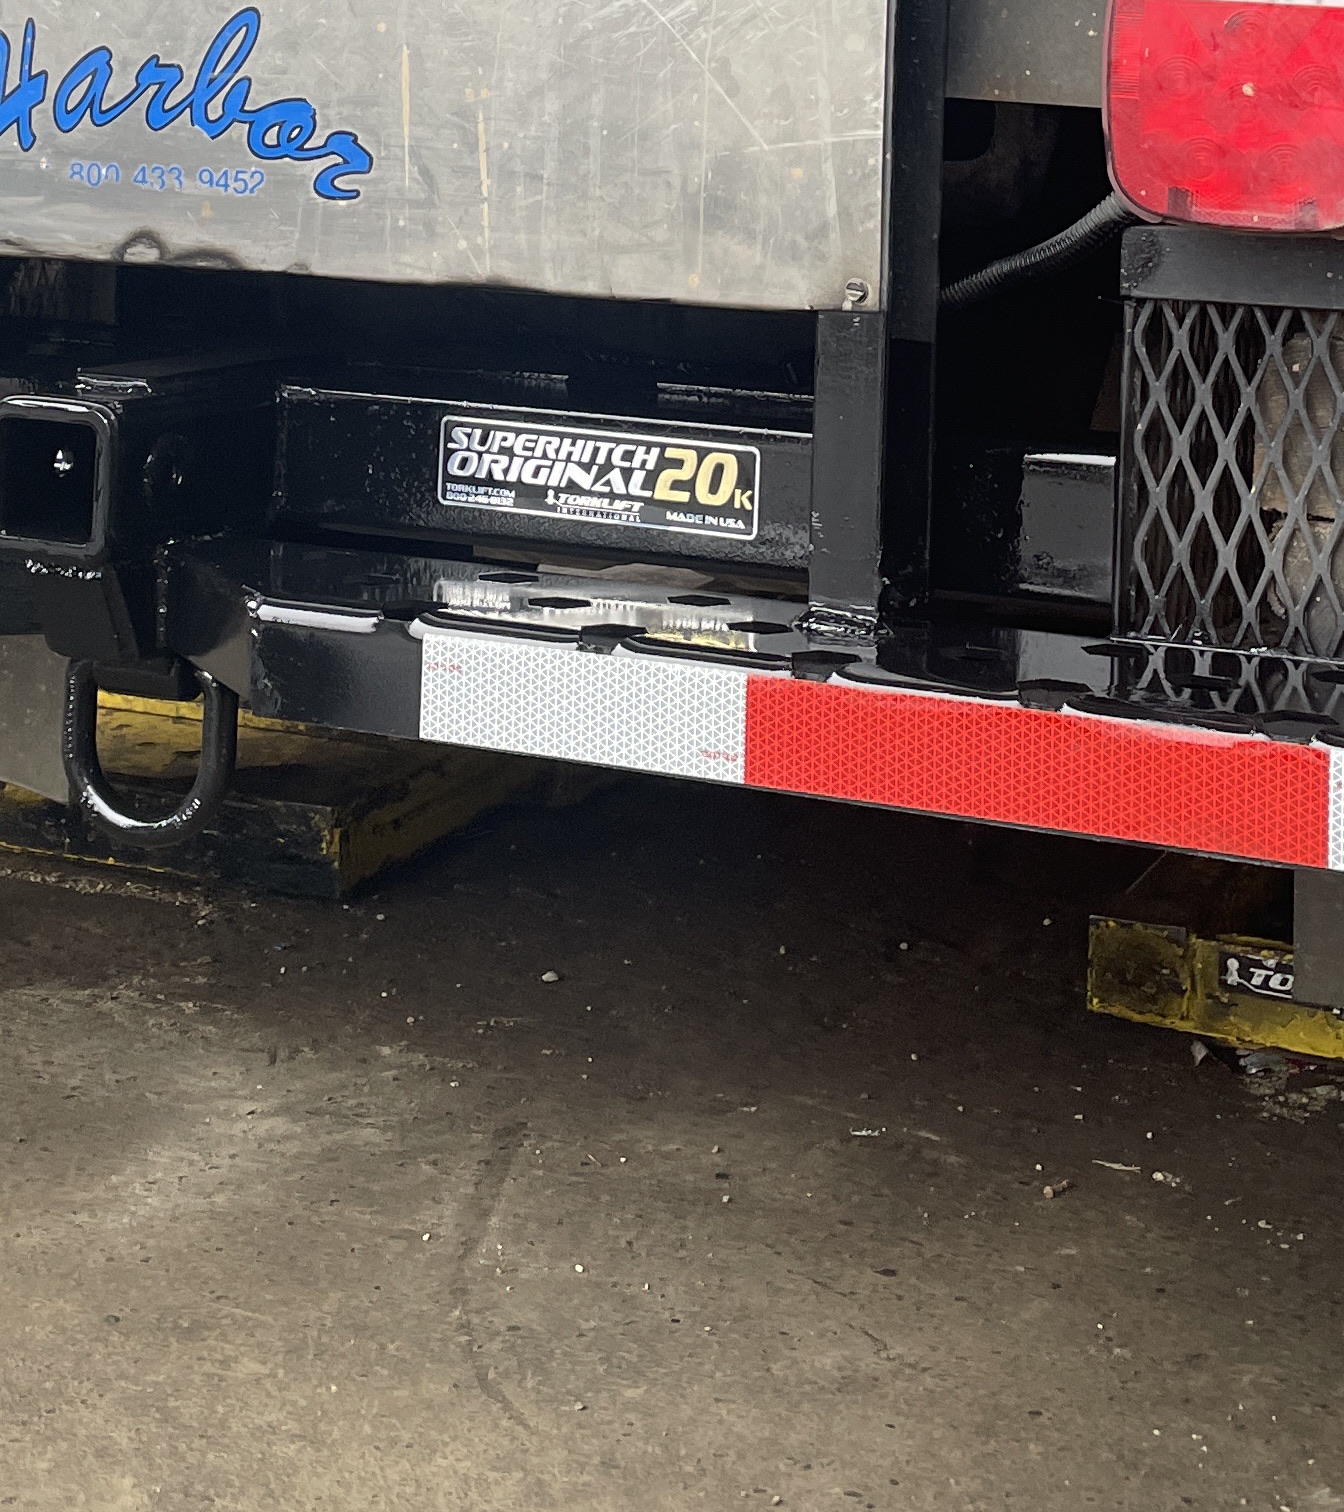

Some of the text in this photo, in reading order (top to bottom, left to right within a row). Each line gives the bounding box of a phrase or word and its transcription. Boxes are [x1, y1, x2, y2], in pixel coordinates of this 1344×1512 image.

[69, 162, 265, 195] 800 433 9452
[447, 427, 661, 471] SUPERHITCH
[447, 450, 655, 499] ORIGINAL
[445, 482, 516, 499] TORKLIFT.COM
[557, 493, 645, 513] TORKLIFT
[666, 510, 746, 530] MADE IN USA
